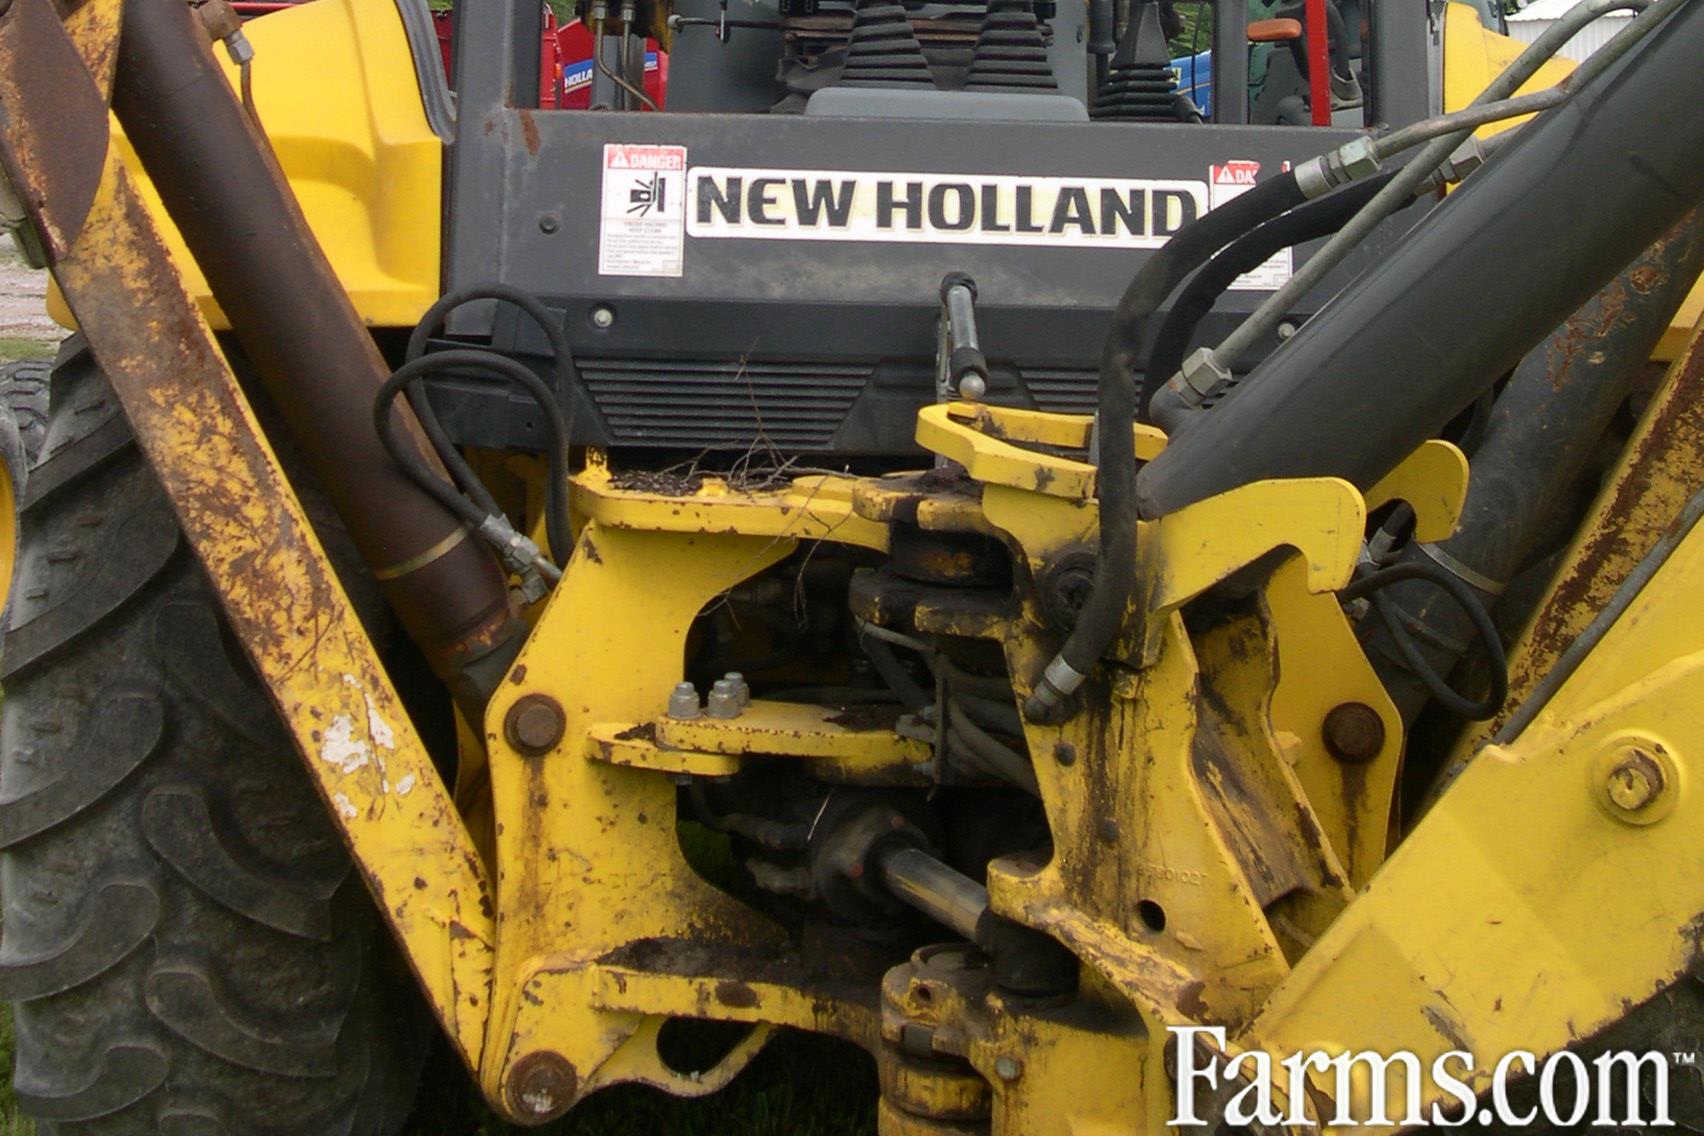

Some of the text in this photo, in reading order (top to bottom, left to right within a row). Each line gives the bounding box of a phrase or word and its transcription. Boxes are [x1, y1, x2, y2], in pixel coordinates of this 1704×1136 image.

[565, 69, 593, 88] HOLLA
[630, 154, 681, 170] DANGER
[695, 174, 1198, 239] NEW HOLLAND
